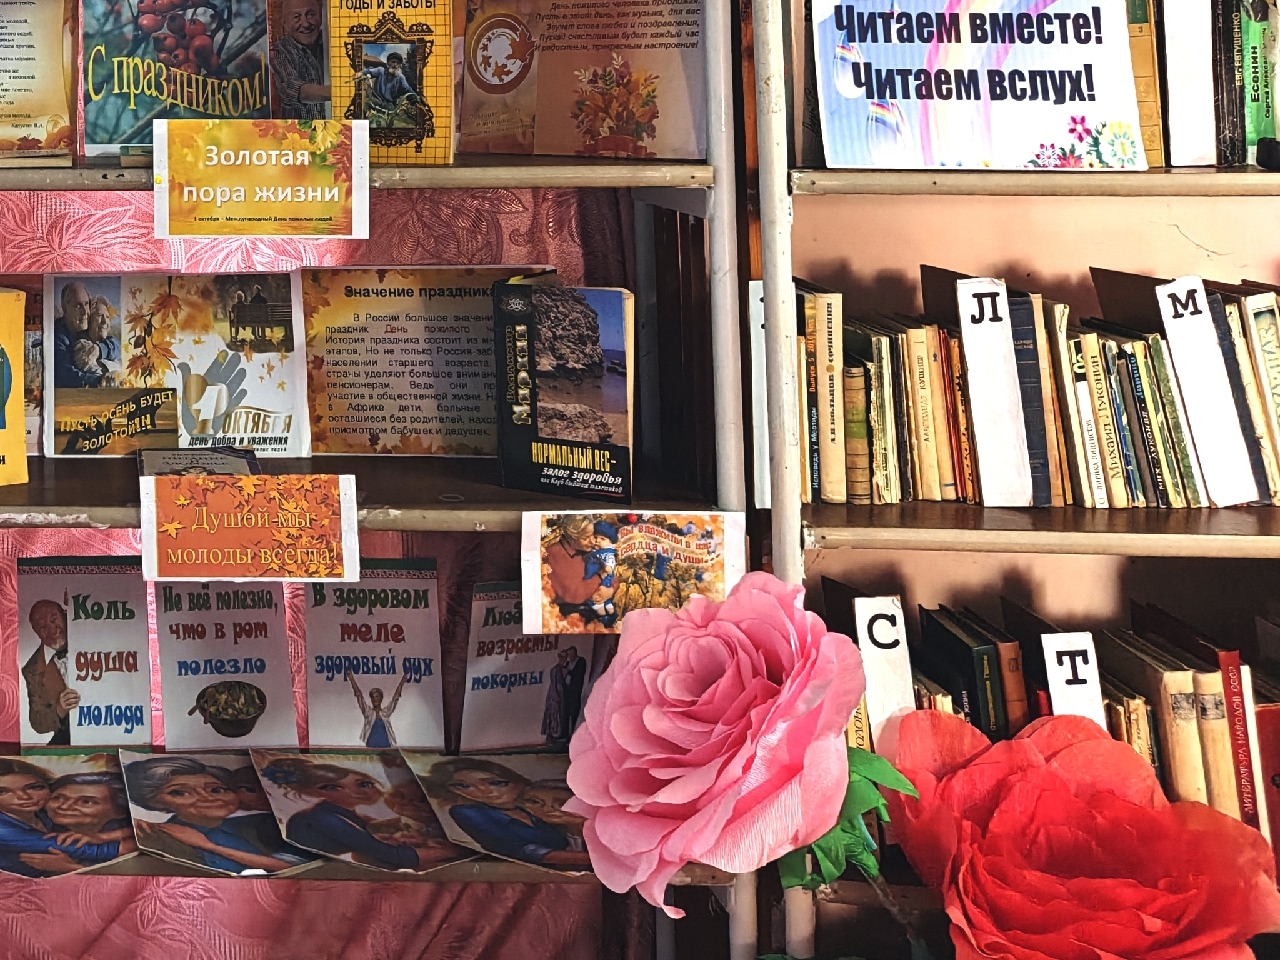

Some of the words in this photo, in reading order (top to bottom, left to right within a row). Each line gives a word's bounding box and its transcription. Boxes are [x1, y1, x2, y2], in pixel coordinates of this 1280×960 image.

[833, 4, 960, 45] Читаем
[970, 6, 1103, 45] вместе!
[1232, 12, 1242, 66] ЕВТУШЕНКО
[88, 43, 107, 102] С
[112, 51, 267, 117] праздником!
[851, 61, 982, 101] Читаем
[987, 63, 1097, 105] вслух!
[1251, 46, 1260, 103] Есенин
[205, 145, 310, 166] Золотая
[183, 186, 246, 207] пора
[254, 186, 339, 202] жизни
[344, 285, 415, 298] Значение
[1171, 288, 1203, 320] М
[353, 314, 359, 322] В
[366, 314, 400, 322] России
[405, 313, 448, 321] большое
[970, 291, 1003, 324] Л
[325, 326, 370, 338] праздник
[384, 325, 408, 335] День
[424, 326, 470, 335] пожилого
[325, 337, 365, 346] История
[370, 337, 419, 346] праздника
[326, 382, 394, 391] пенсионерам.
[410, 381, 434, 390] Ведь
[512, 324, 531, 425] Миркин
[1090, 355, 1110, 419] Луконин
[140, 391, 174, 408] БУДЕТ
[347, 403, 384, 413] Африке
[377, 392, 447, 401] общественной
[189, 435, 209, 447] день
[211, 435, 236, 447] добра
[238, 436, 245, 445] и
[247, 435, 288, 447] уважения
[391, 427, 434, 436] бабушек
[531, 441, 592, 470] НОРМАЛЬНЫЙ
[594, 449, 611, 472] ВЕС
[1103, 423, 1122, 479] Михаил
[542, 466, 570, 479] залог
[571, 468, 622, 485] здоровья
[191, 506, 270, 533] Душой
[277, 512, 312, 529] мы
[167, 548, 252, 565] молоды
[260, 547, 338, 565] всегда!
[72, 594, 136, 621] Коль
[162, 586, 182, 614] Не
[188, 584, 211, 612] всё
[216, 588, 278, 615] полезно,
[311, 582, 327, 607] В
[332, 586, 430, 616] здоровом
[168, 622, 207, 641] что
[214, 622, 226, 639] в
[234, 621, 268, 645] рот
[339, 621, 405, 644] теле
[866, 613, 901, 650] С
[476, 635, 559, 661] возрасты
[76, 650, 139, 682] душа
[177, 657, 266, 677] полезло
[315, 648, 397, 681] здоровый
[402, 657, 434, 684] дух
[1055, 648, 1090, 687] Т
[471, 669, 544, 693] покорны
[76, 704, 145, 734] молода
[1233, 695, 1246, 745] НАРОДОВ
